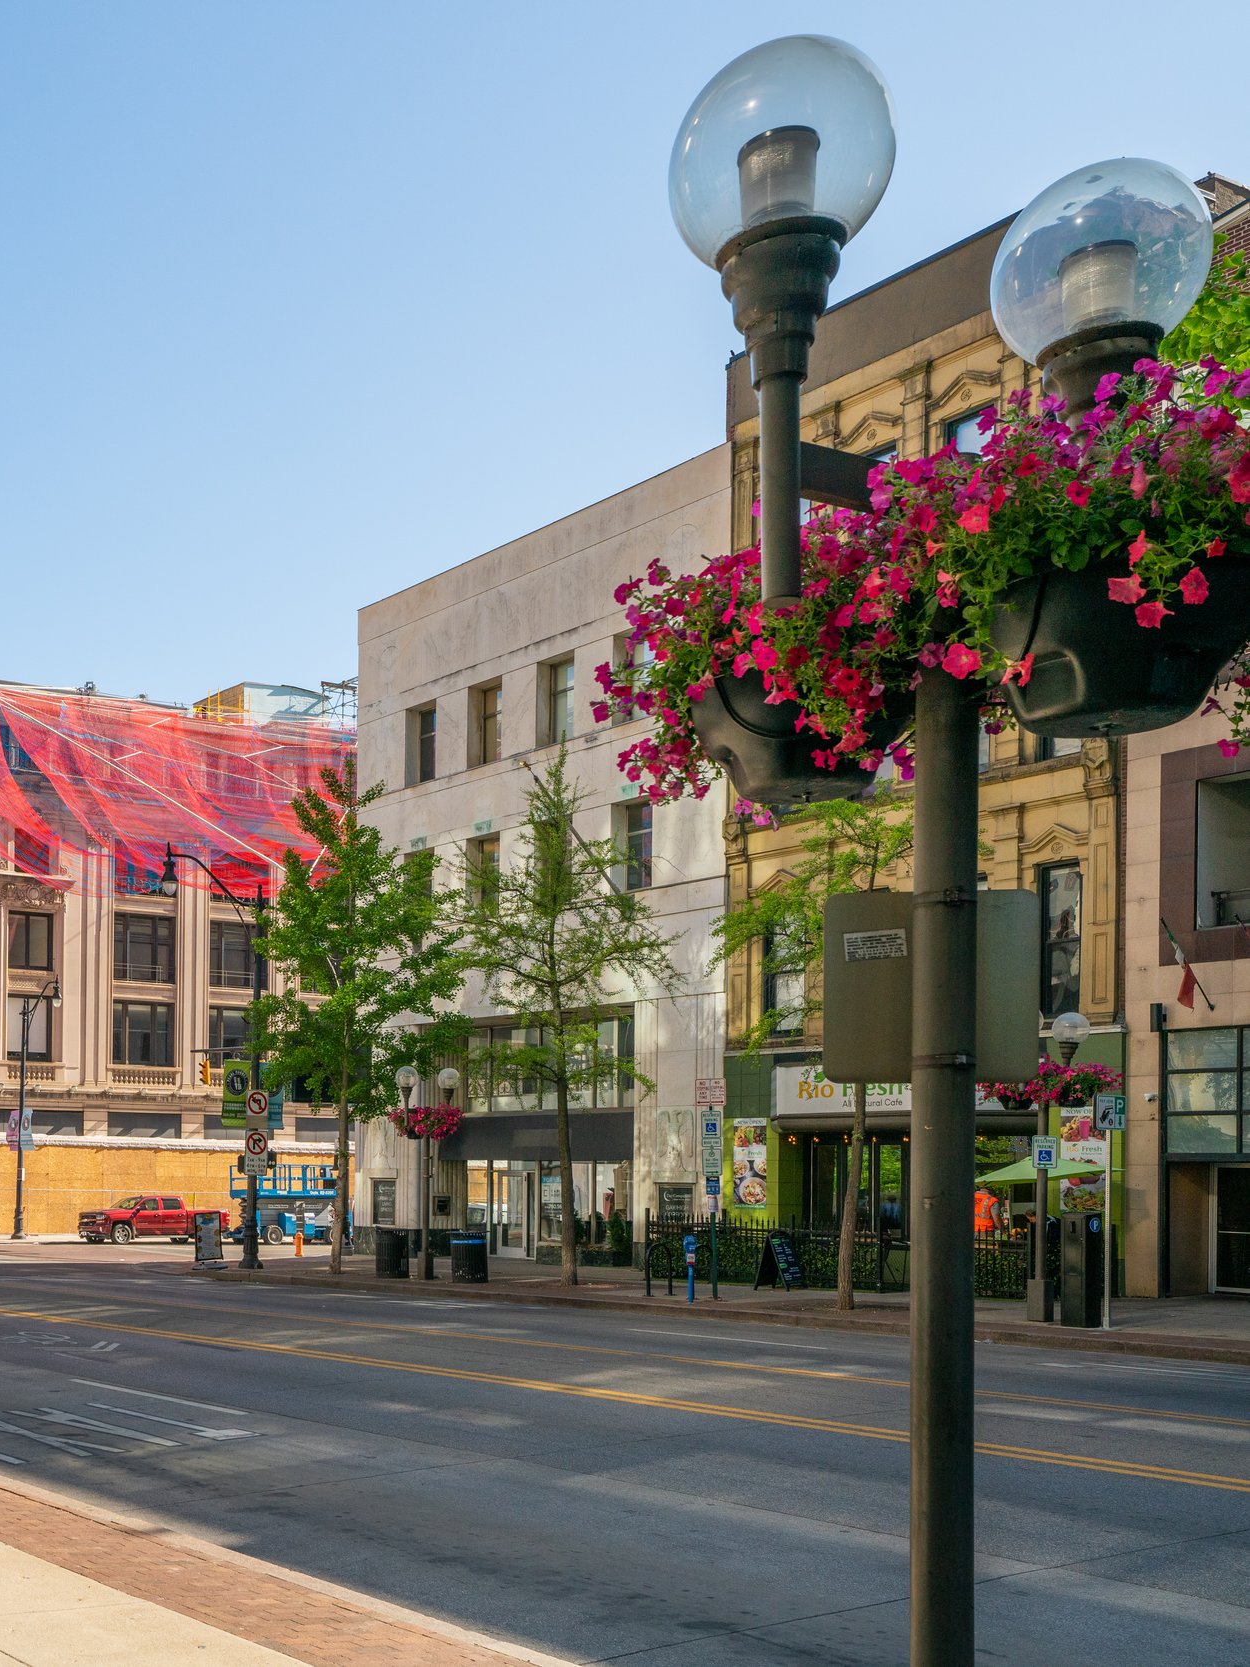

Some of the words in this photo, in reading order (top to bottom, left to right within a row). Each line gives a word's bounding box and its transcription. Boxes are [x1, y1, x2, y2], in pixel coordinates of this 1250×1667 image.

[798, 1082, 834, 1100] Rio
[1116, 1098, 1124, 1112] P
[1093, 1221, 1099, 1230] P
